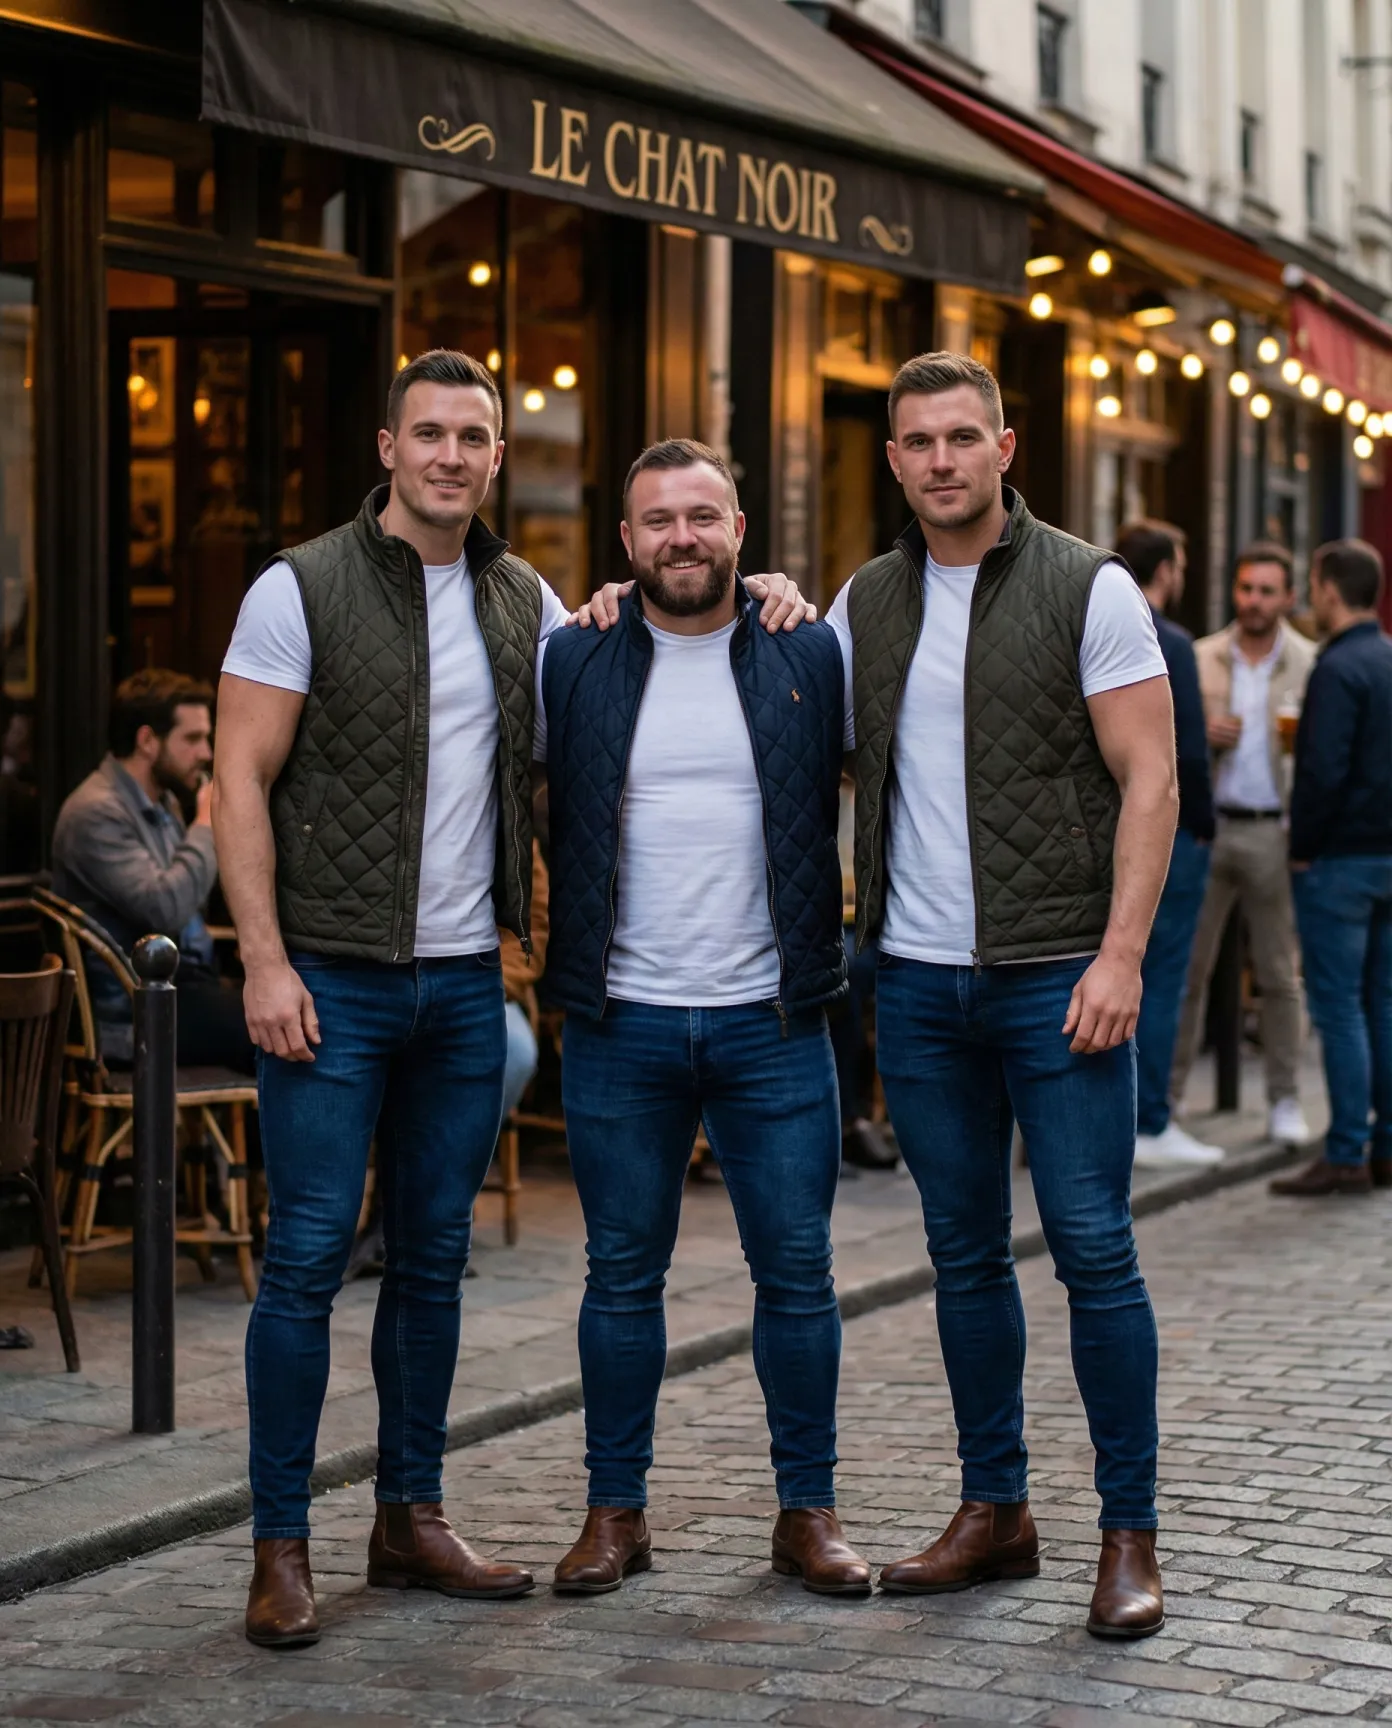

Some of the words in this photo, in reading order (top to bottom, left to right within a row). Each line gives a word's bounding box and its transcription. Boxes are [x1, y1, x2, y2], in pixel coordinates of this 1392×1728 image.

[529, 99, 591, 187] LE
[604, 121, 726, 216] CHAT
[736, 153, 838, 242] NOIR
